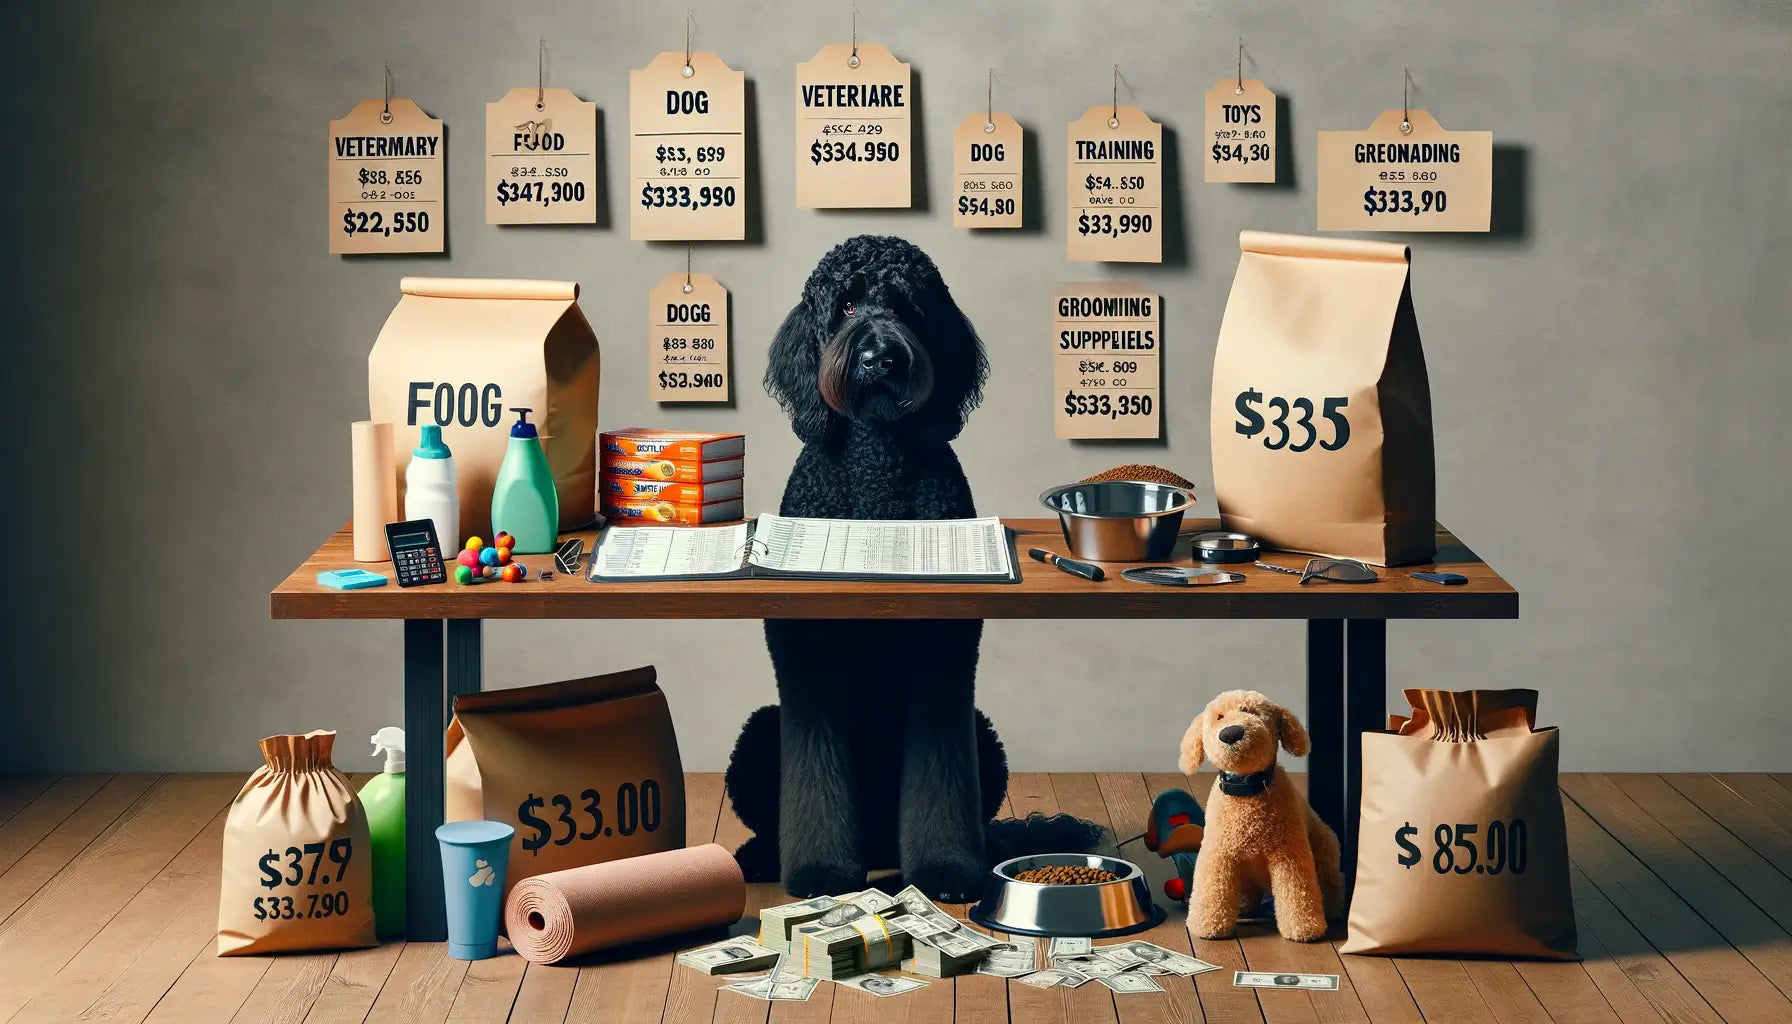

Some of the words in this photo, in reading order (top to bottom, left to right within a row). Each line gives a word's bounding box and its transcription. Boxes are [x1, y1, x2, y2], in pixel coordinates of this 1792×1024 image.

[666, 90, 709, 115] DOG
[801, 84, 905, 108] VETERIARE
[1221, 104, 1262, 126] TOYS
[971, 143, 1005, 162] DOG
[1075, 140, 1155, 160] TRAINING
[1354, 143, 1460, 164] GREONADING
[1078, 208, 1153, 239] $33,990
[666, 303, 711, 323] DOGG
[405, 382, 502, 428] FOOG
[1234, 386, 1351, 453] $335
[517, 779, 662, 857] $33.00
[1394, 821, 1422, 870] $
[1432, 818, 1528, 876] 85.00
[258, 836, 353, 891] $37.9
